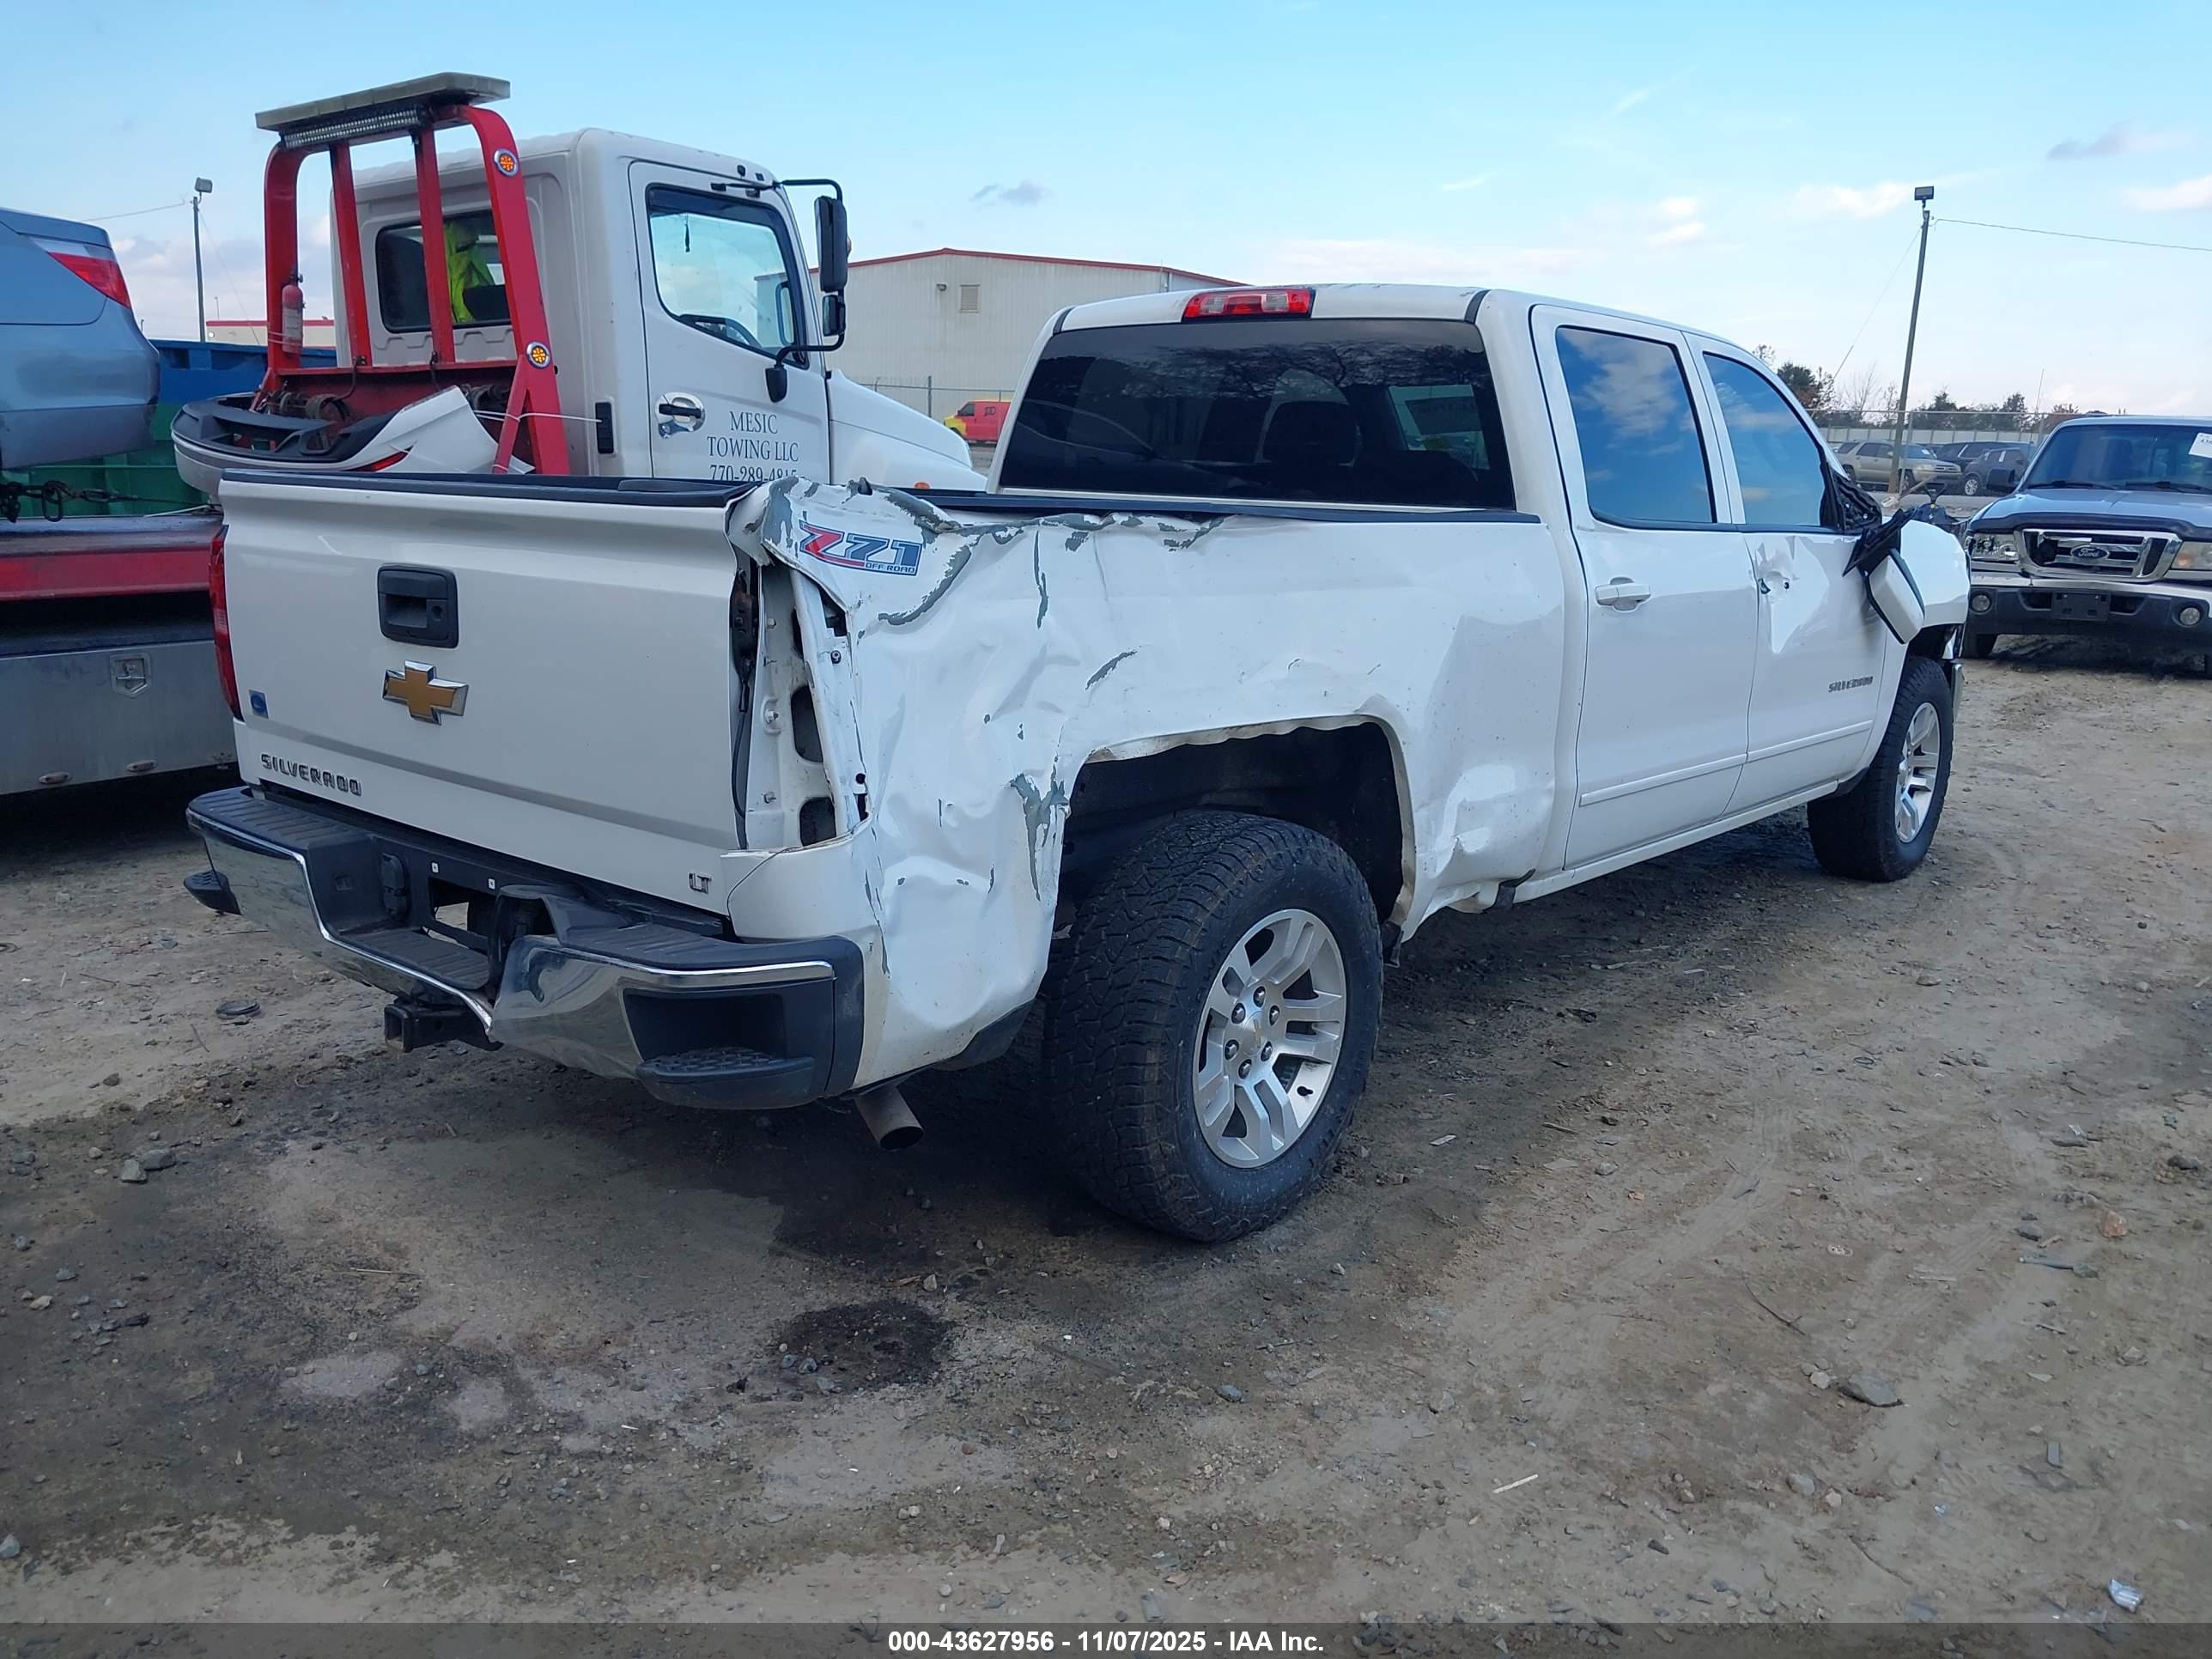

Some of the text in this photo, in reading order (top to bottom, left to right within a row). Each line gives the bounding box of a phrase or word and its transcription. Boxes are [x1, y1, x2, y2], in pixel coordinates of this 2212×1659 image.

[729, 410, 778, 434] MESIC
[707, 435, 799, 462] TOWING LLC
[799, 520, 922, 576] Z71
[2078, 547, 2100, 557] Ford
[886, 565, 915, 574] ROAD
[261, 753, 362, 797] SILVERADO
[689, 872, 711, 894] LT
